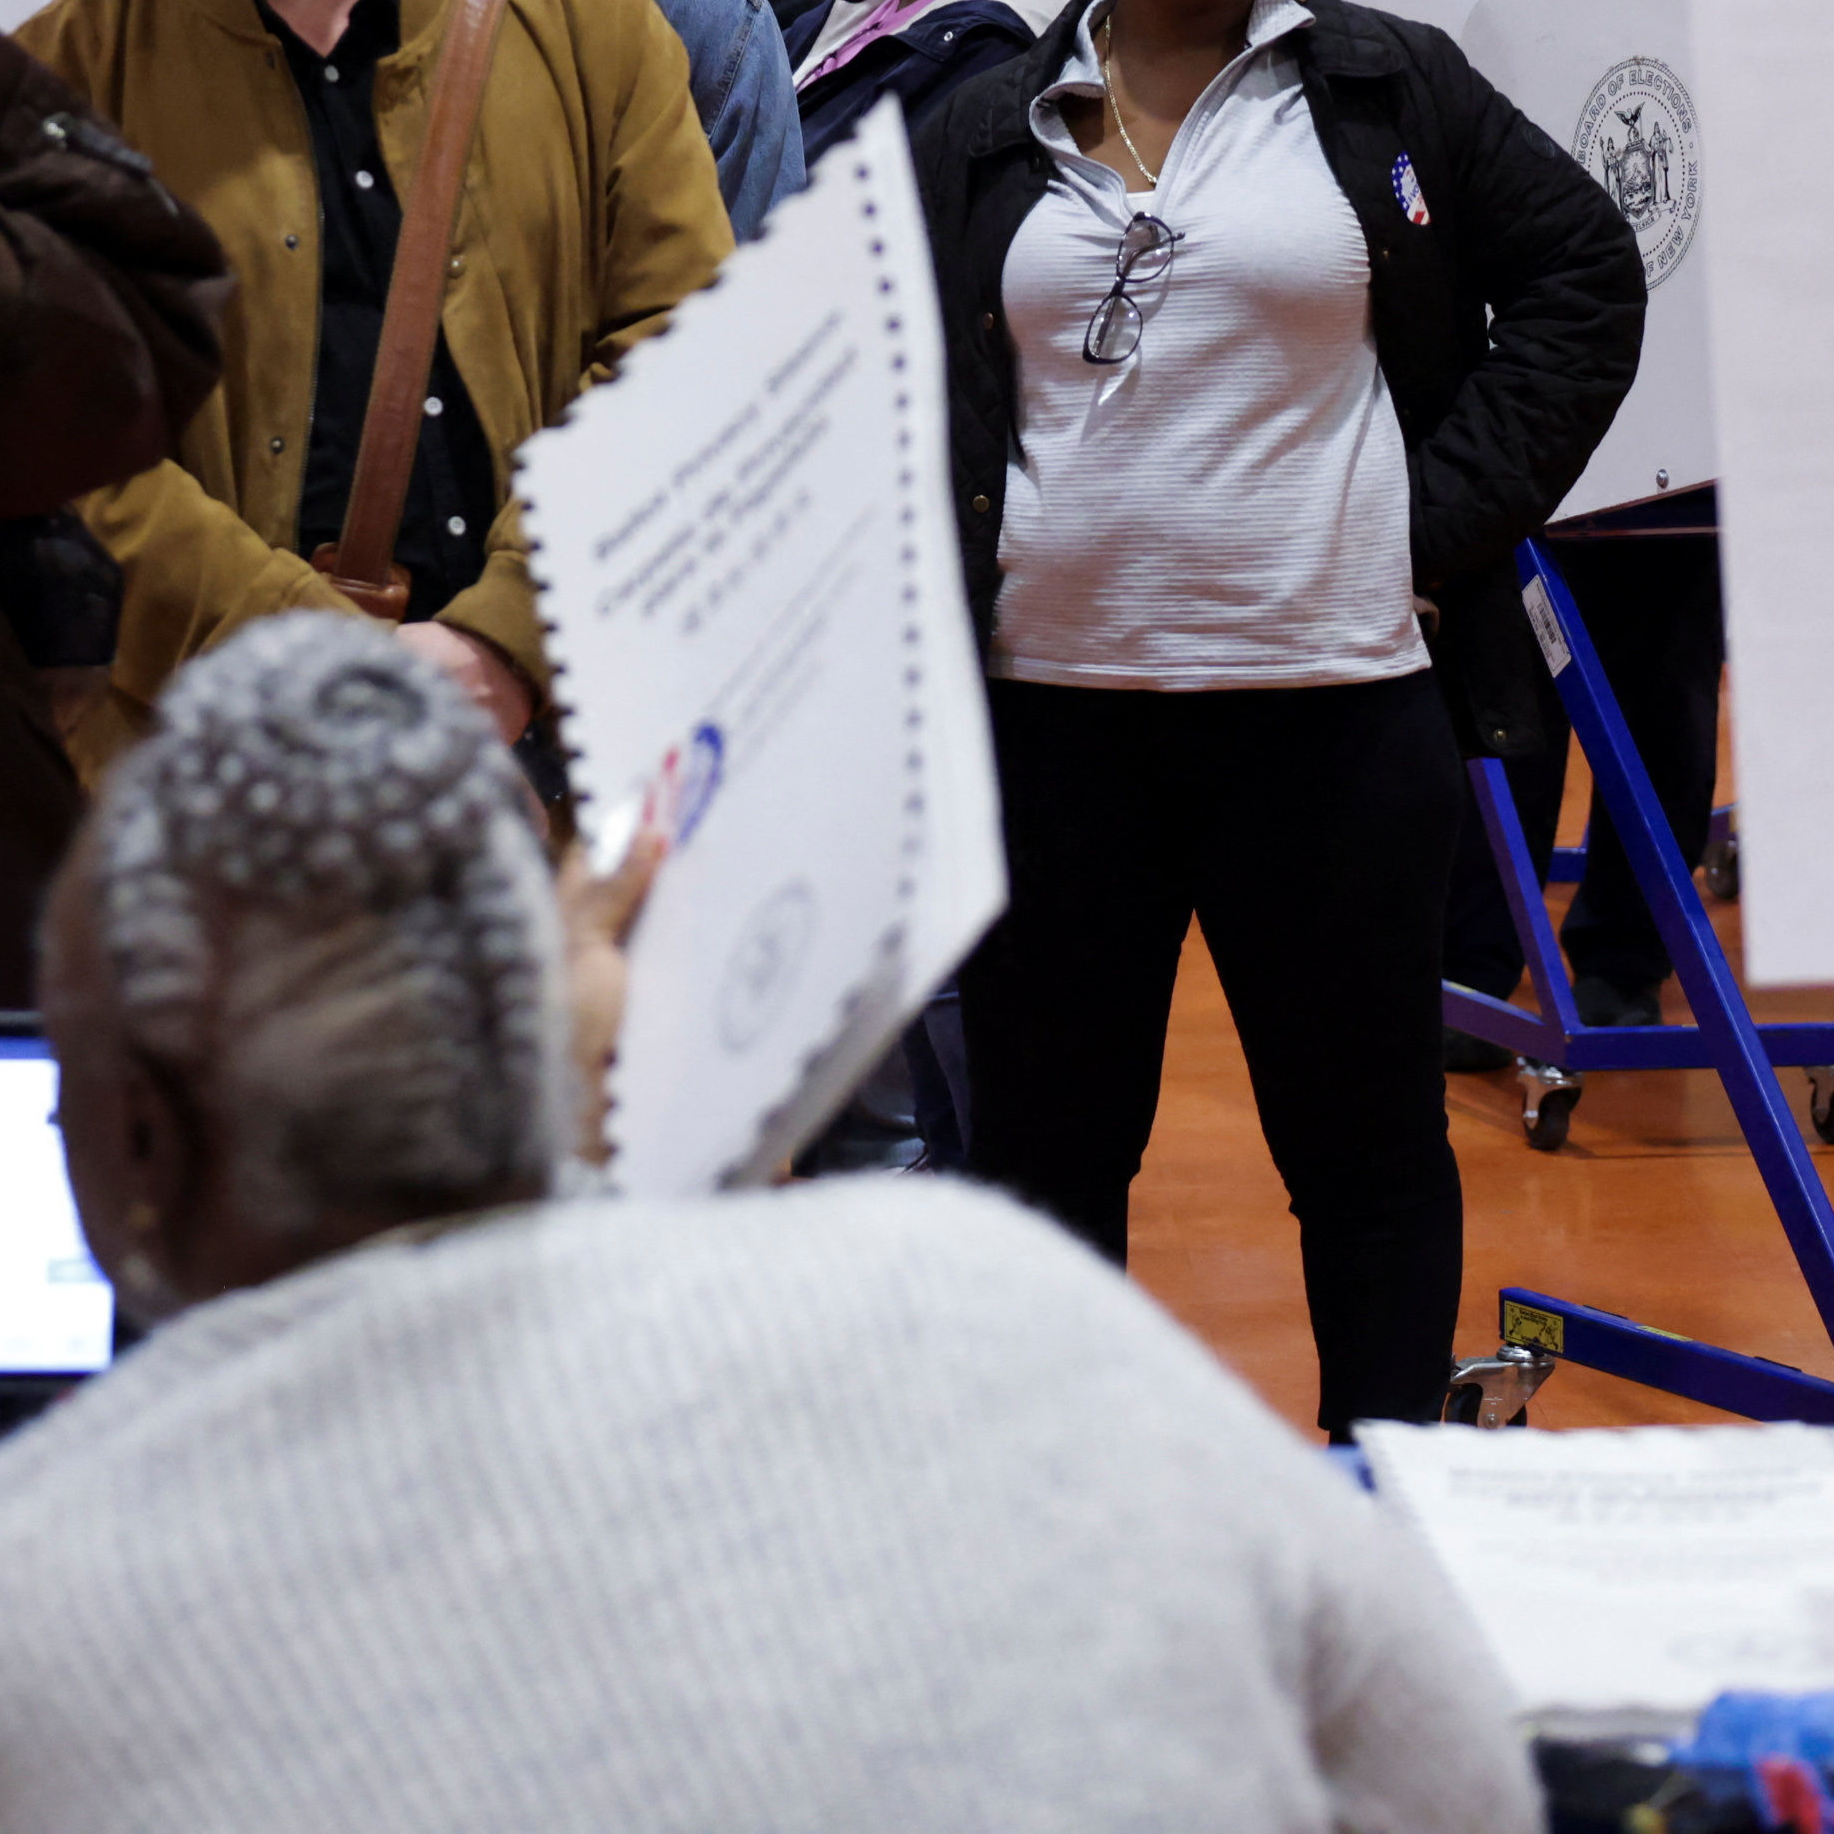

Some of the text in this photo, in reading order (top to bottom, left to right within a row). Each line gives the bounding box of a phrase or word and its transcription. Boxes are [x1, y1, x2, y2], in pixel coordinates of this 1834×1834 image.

[1577, 68, 1693, 165] BOARD OF ELECTIONS
[1656, 224, 1685, 270] NEW
[1680, 159, 1698, 221] YORK
